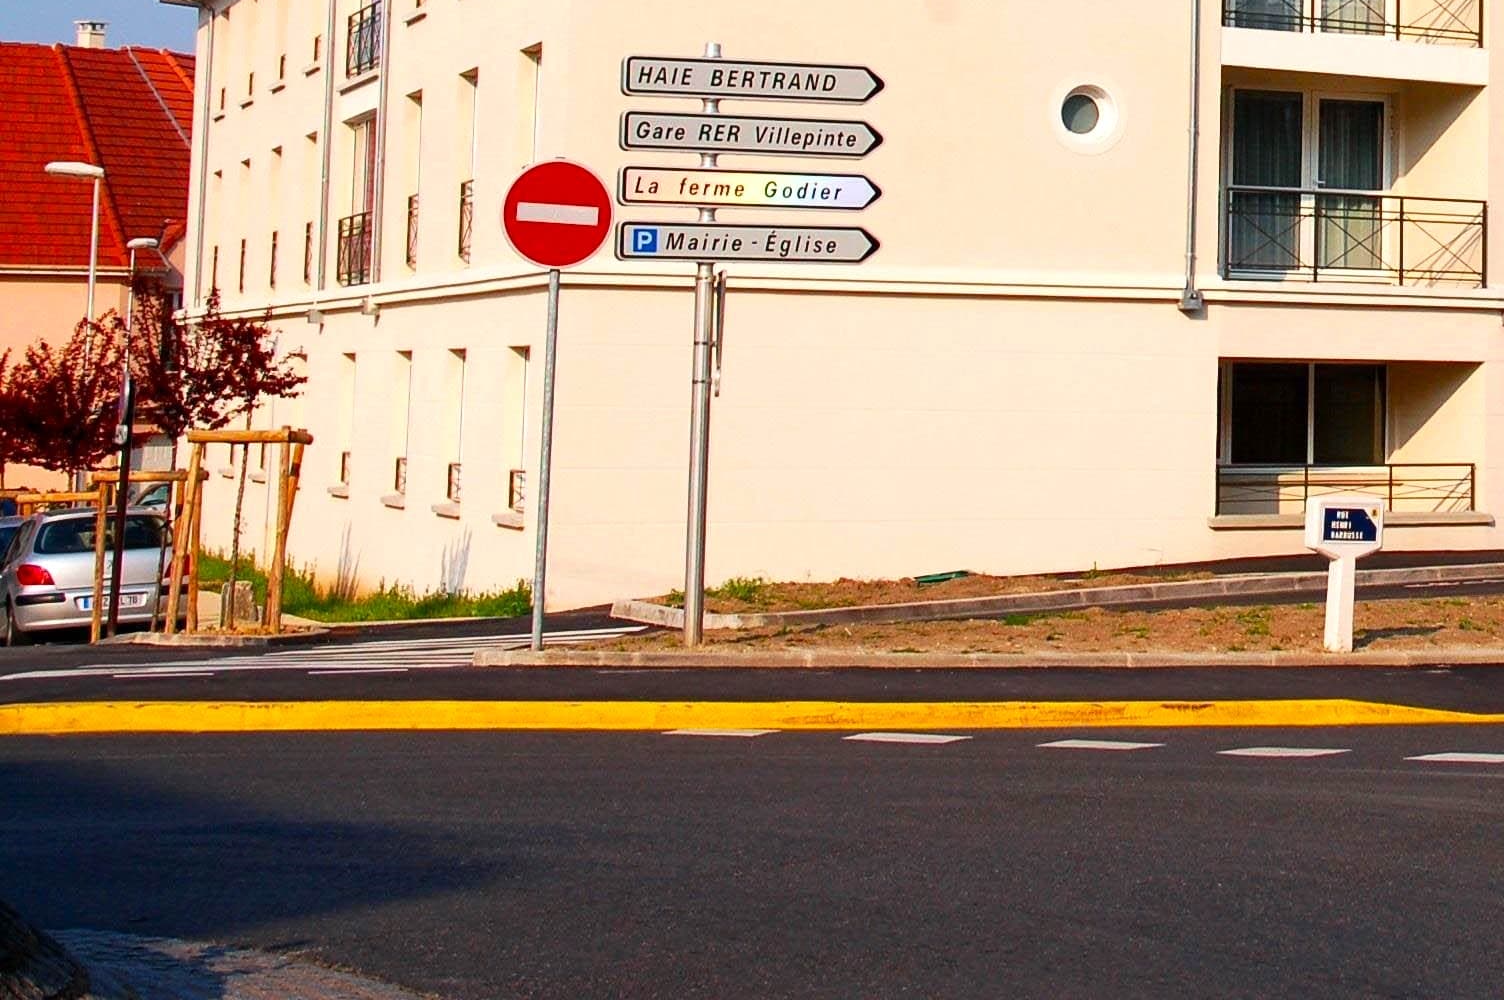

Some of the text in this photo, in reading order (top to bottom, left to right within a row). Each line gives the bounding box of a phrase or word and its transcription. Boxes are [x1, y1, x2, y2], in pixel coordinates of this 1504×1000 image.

[638, 66, 837, 92] HAIE BERTRAND
[636, 121, 857, 149] Gare RER Villepinte
[635, 176, 842, 200] La ferme Godier
[636, 231, 653, 250] P
[665, 232, 743, 252] Mairie
[765, 230, 837, 257] Église
